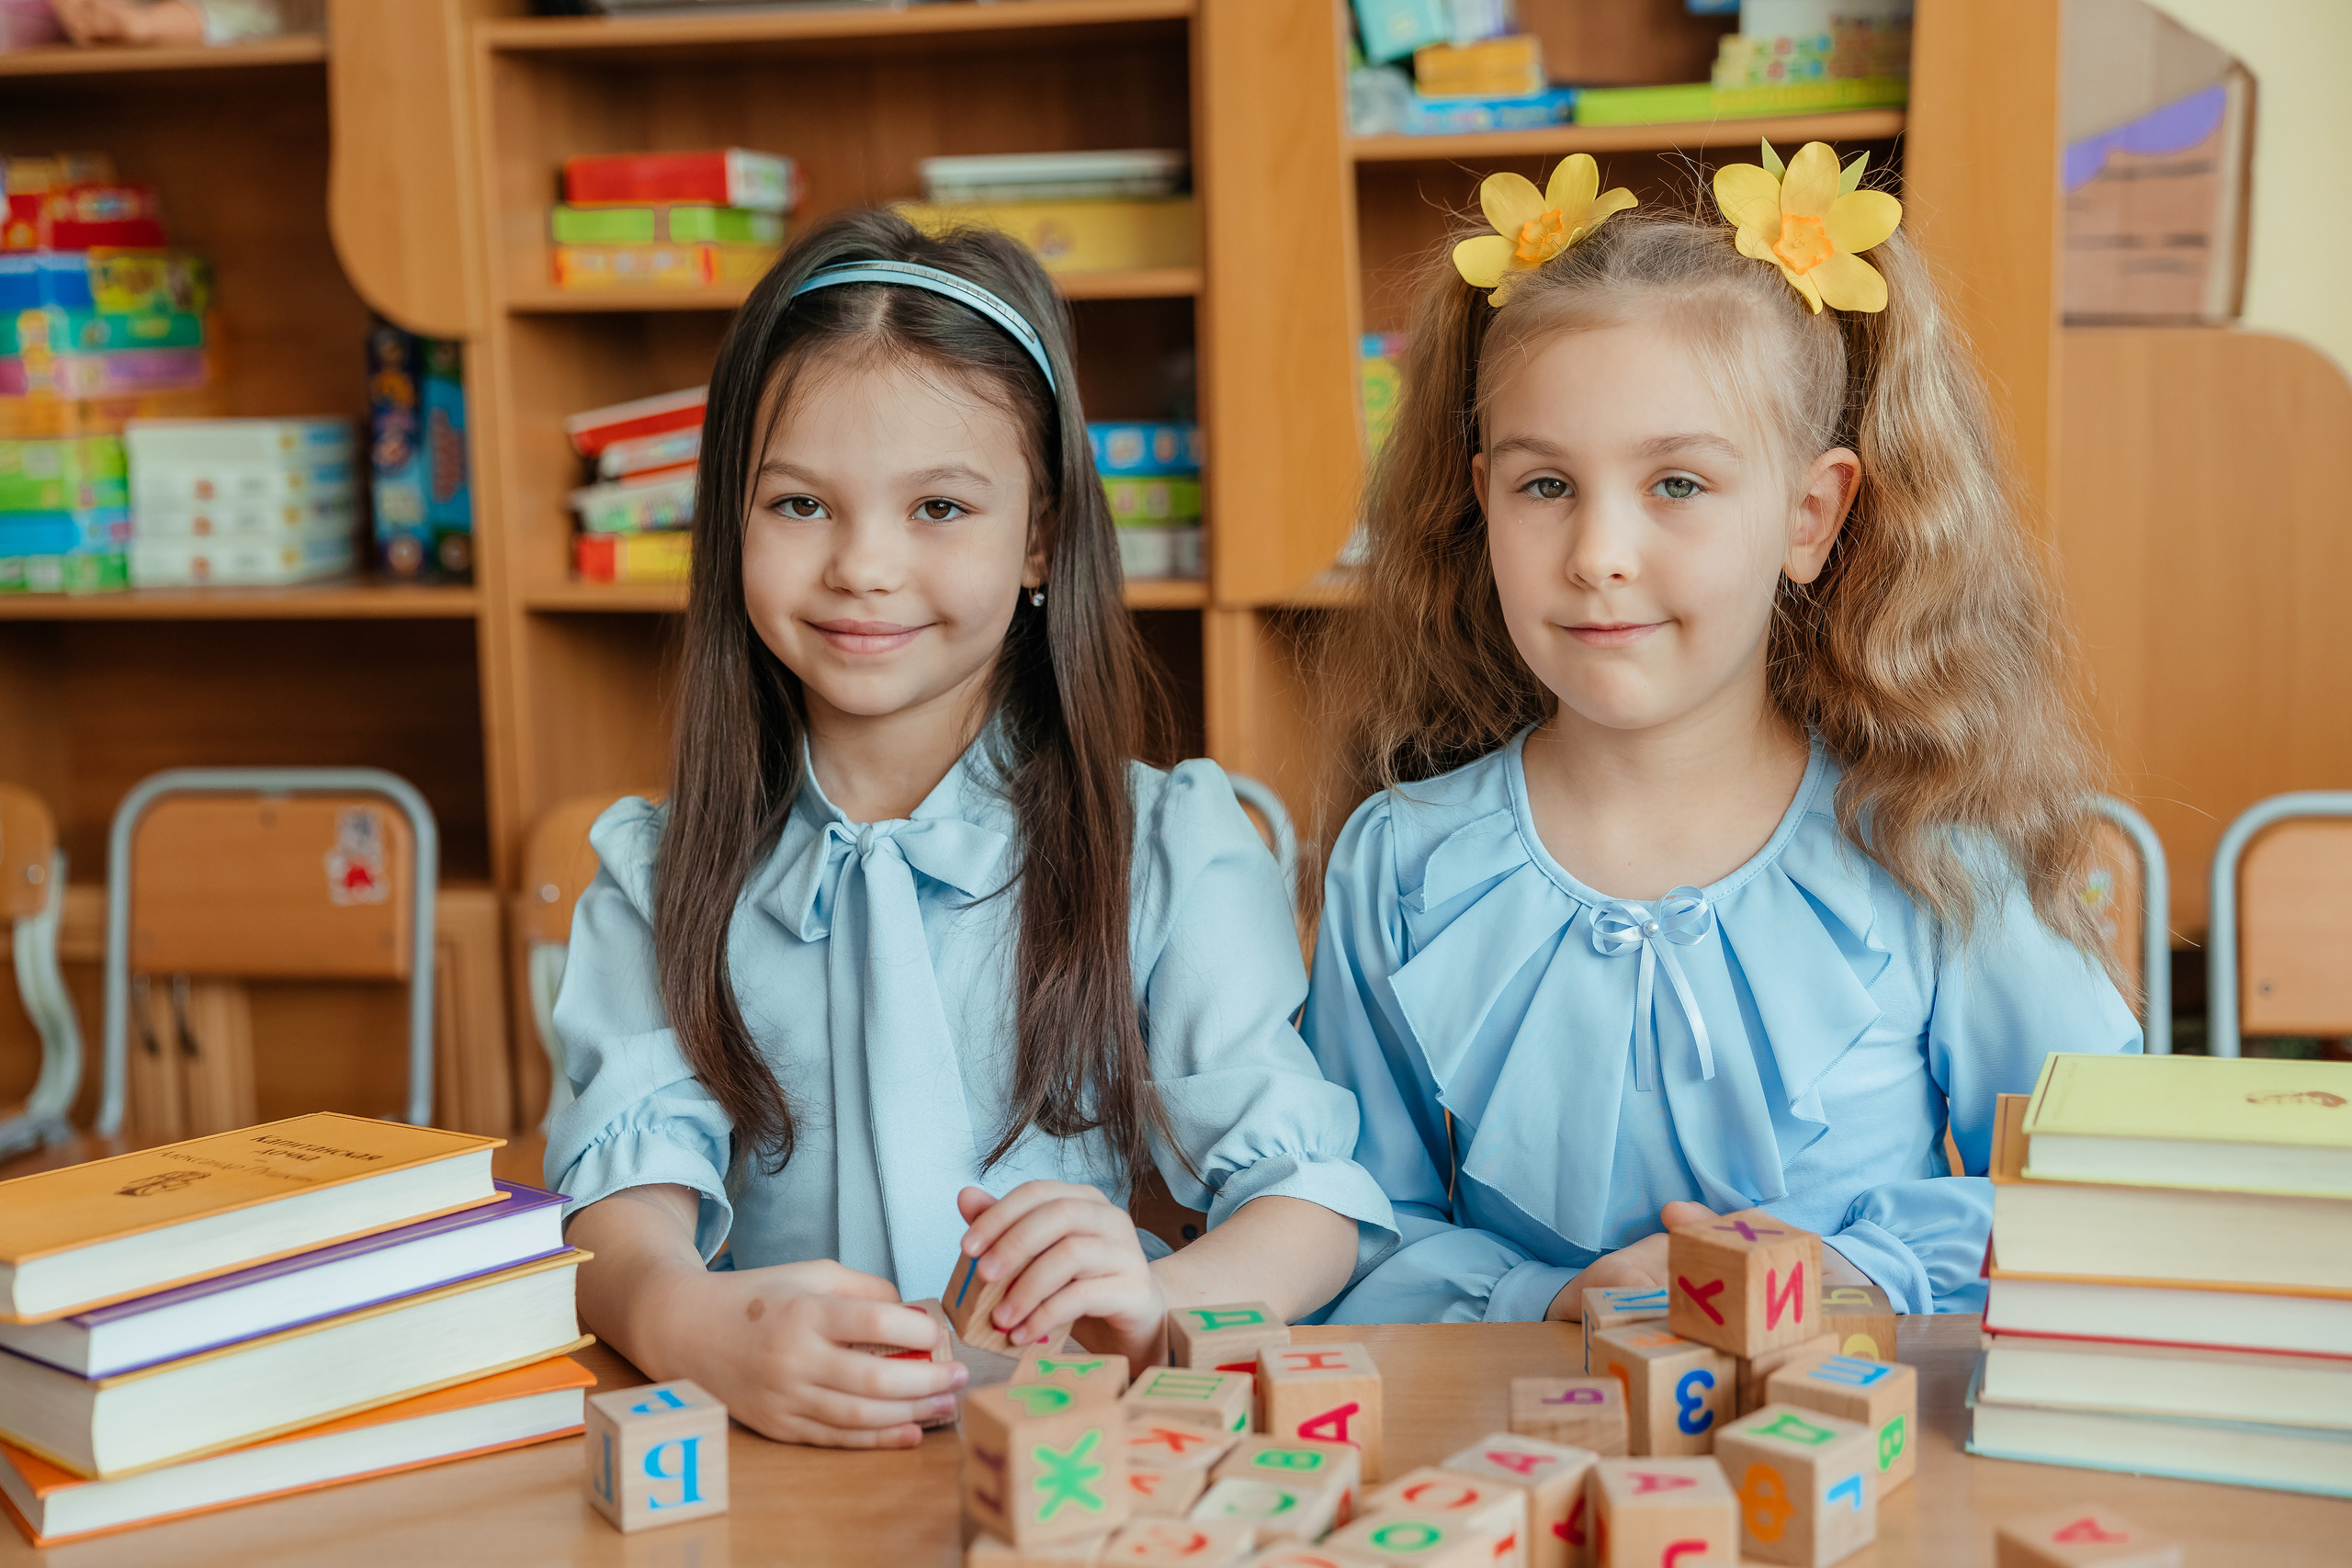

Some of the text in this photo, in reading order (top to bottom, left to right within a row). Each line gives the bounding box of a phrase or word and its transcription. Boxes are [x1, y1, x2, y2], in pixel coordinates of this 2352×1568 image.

[250, 1134, 384, 1161] Капитанская
[1766, 1259, 1804, 1332] И
[1296, 1401, 1362, 1451] А
[642, 1434, 707, 1512] Б
[1030, 1428, 1105, 1523] Ж
